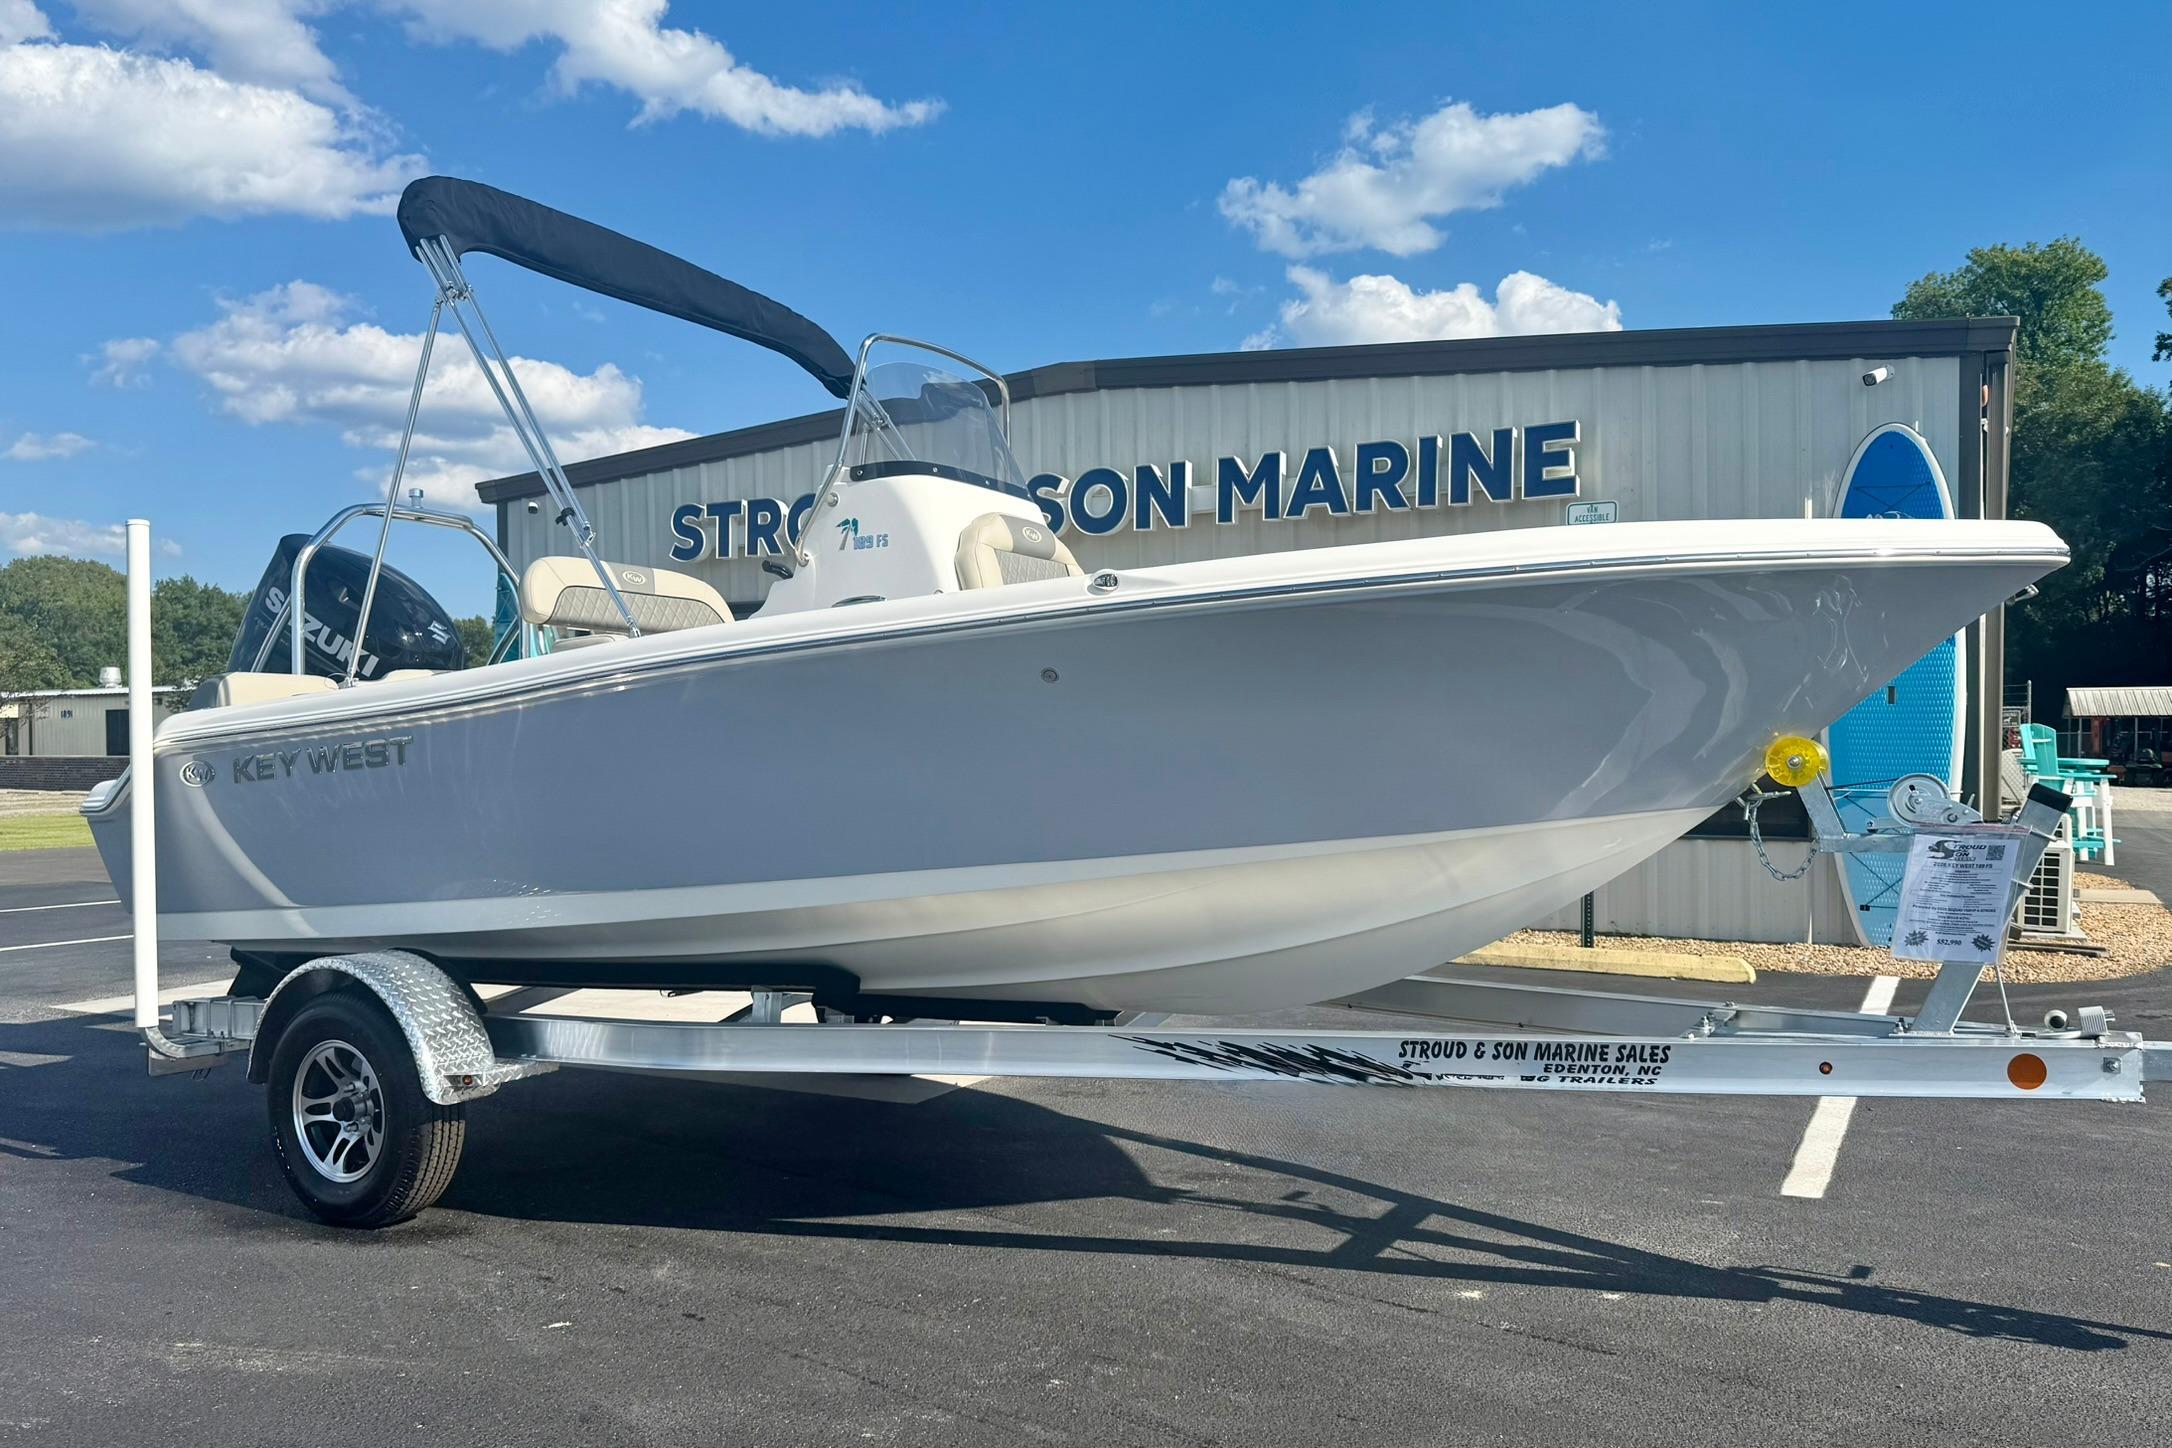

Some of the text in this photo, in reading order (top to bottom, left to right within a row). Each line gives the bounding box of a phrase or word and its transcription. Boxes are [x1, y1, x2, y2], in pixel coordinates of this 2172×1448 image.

[1026, 460, 1192, 536] SON
[1215, 420, 1581, 525] MARINE
[1574, 512, 1610, 523] ACCESSIBLE
[876, 534, 889, 548] FS
[264, 586, 380, 677] SZUKI
[233, 735, 413, 784] KEY WEST
[1398, 1040, 1671, 1064] STROUD & SON MARINE SALES
[1543, 1063, 1662, 1077] EDENTON, NC
[1558, 1075, 1658, 1085] TRAILERS
